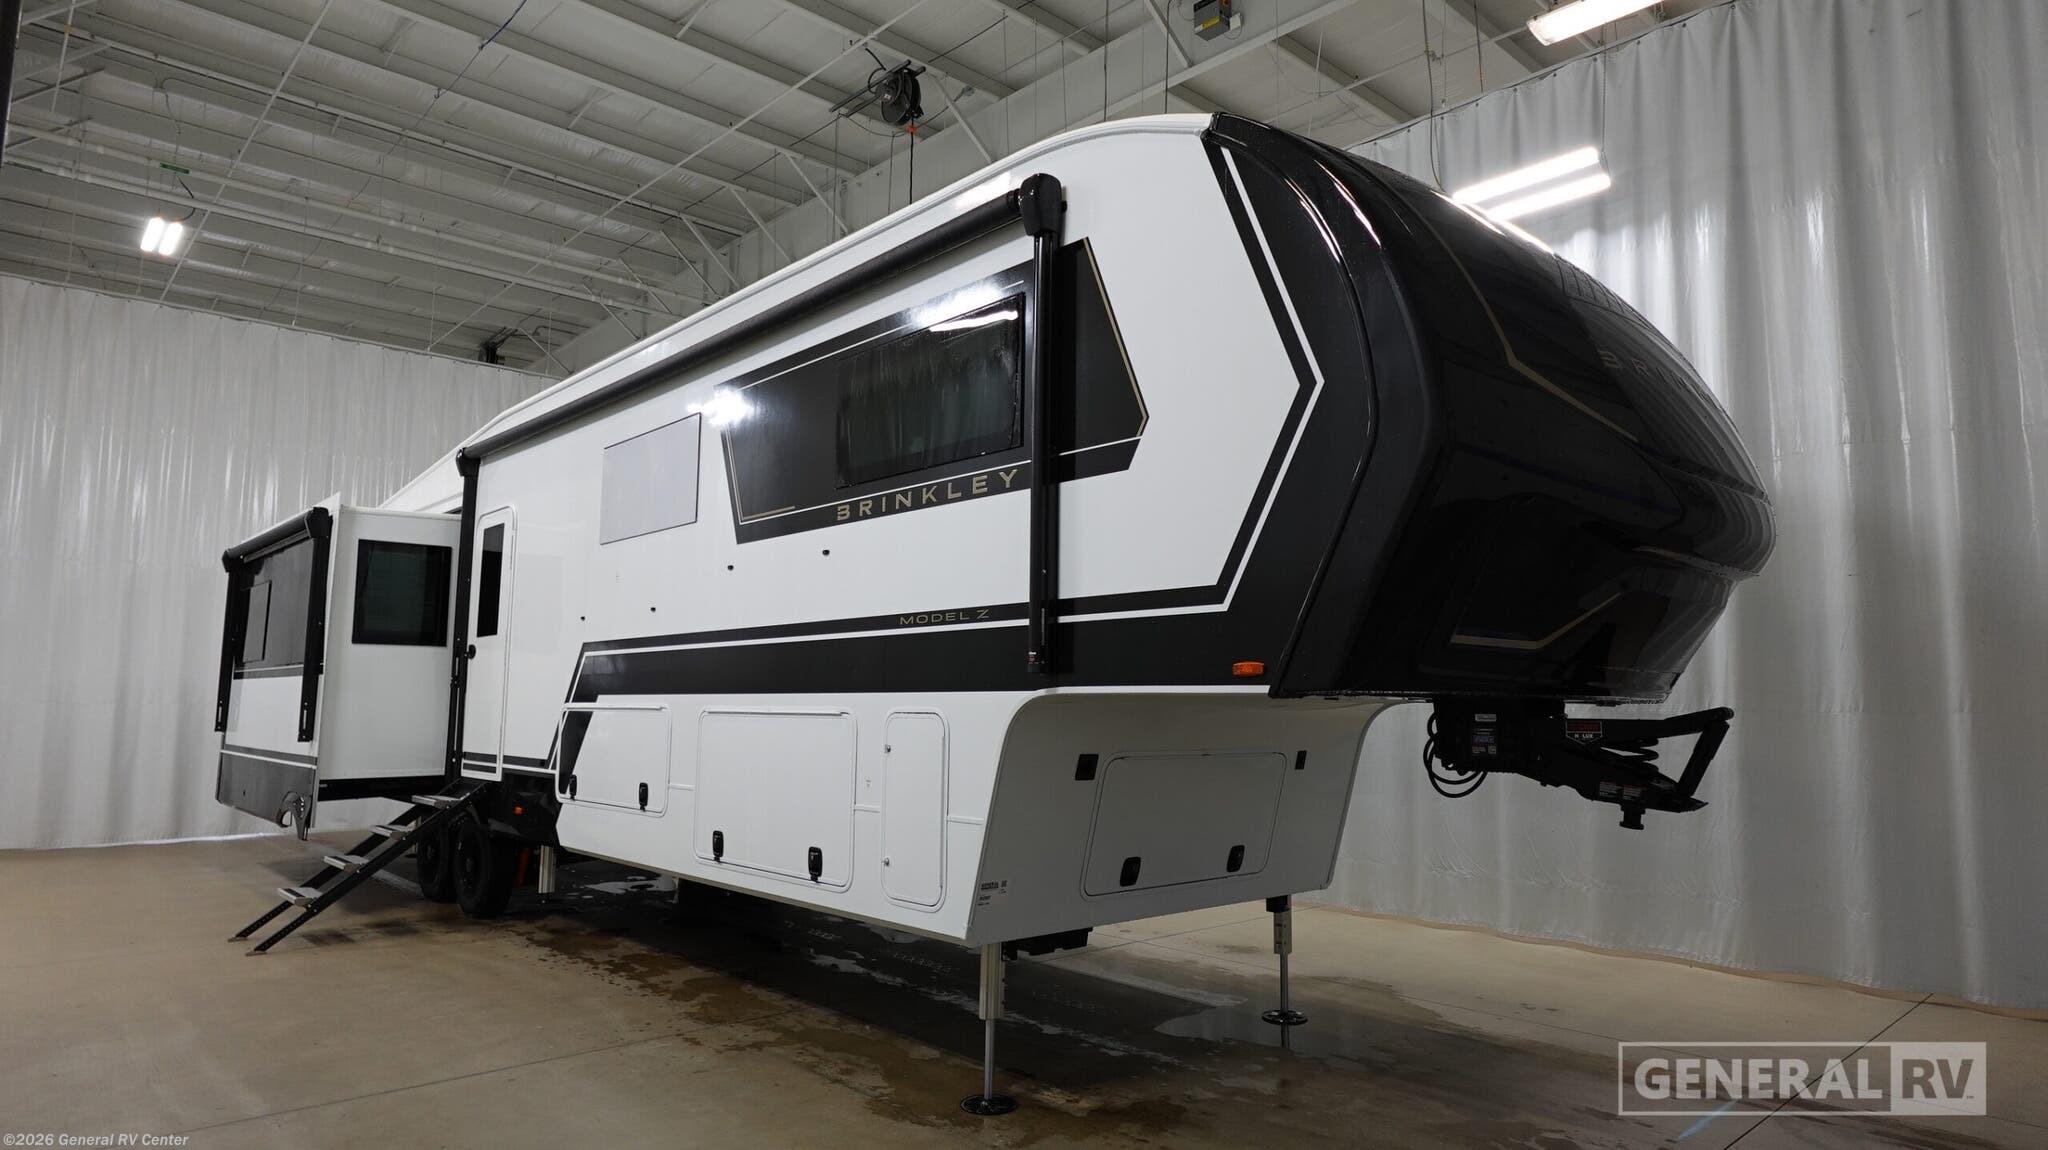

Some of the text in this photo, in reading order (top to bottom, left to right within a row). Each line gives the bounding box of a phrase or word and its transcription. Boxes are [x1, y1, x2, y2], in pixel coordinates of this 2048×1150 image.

[837, 468, 1018, 521] BRINKLEY
[900, 608, 990, 625] MODEL Z
